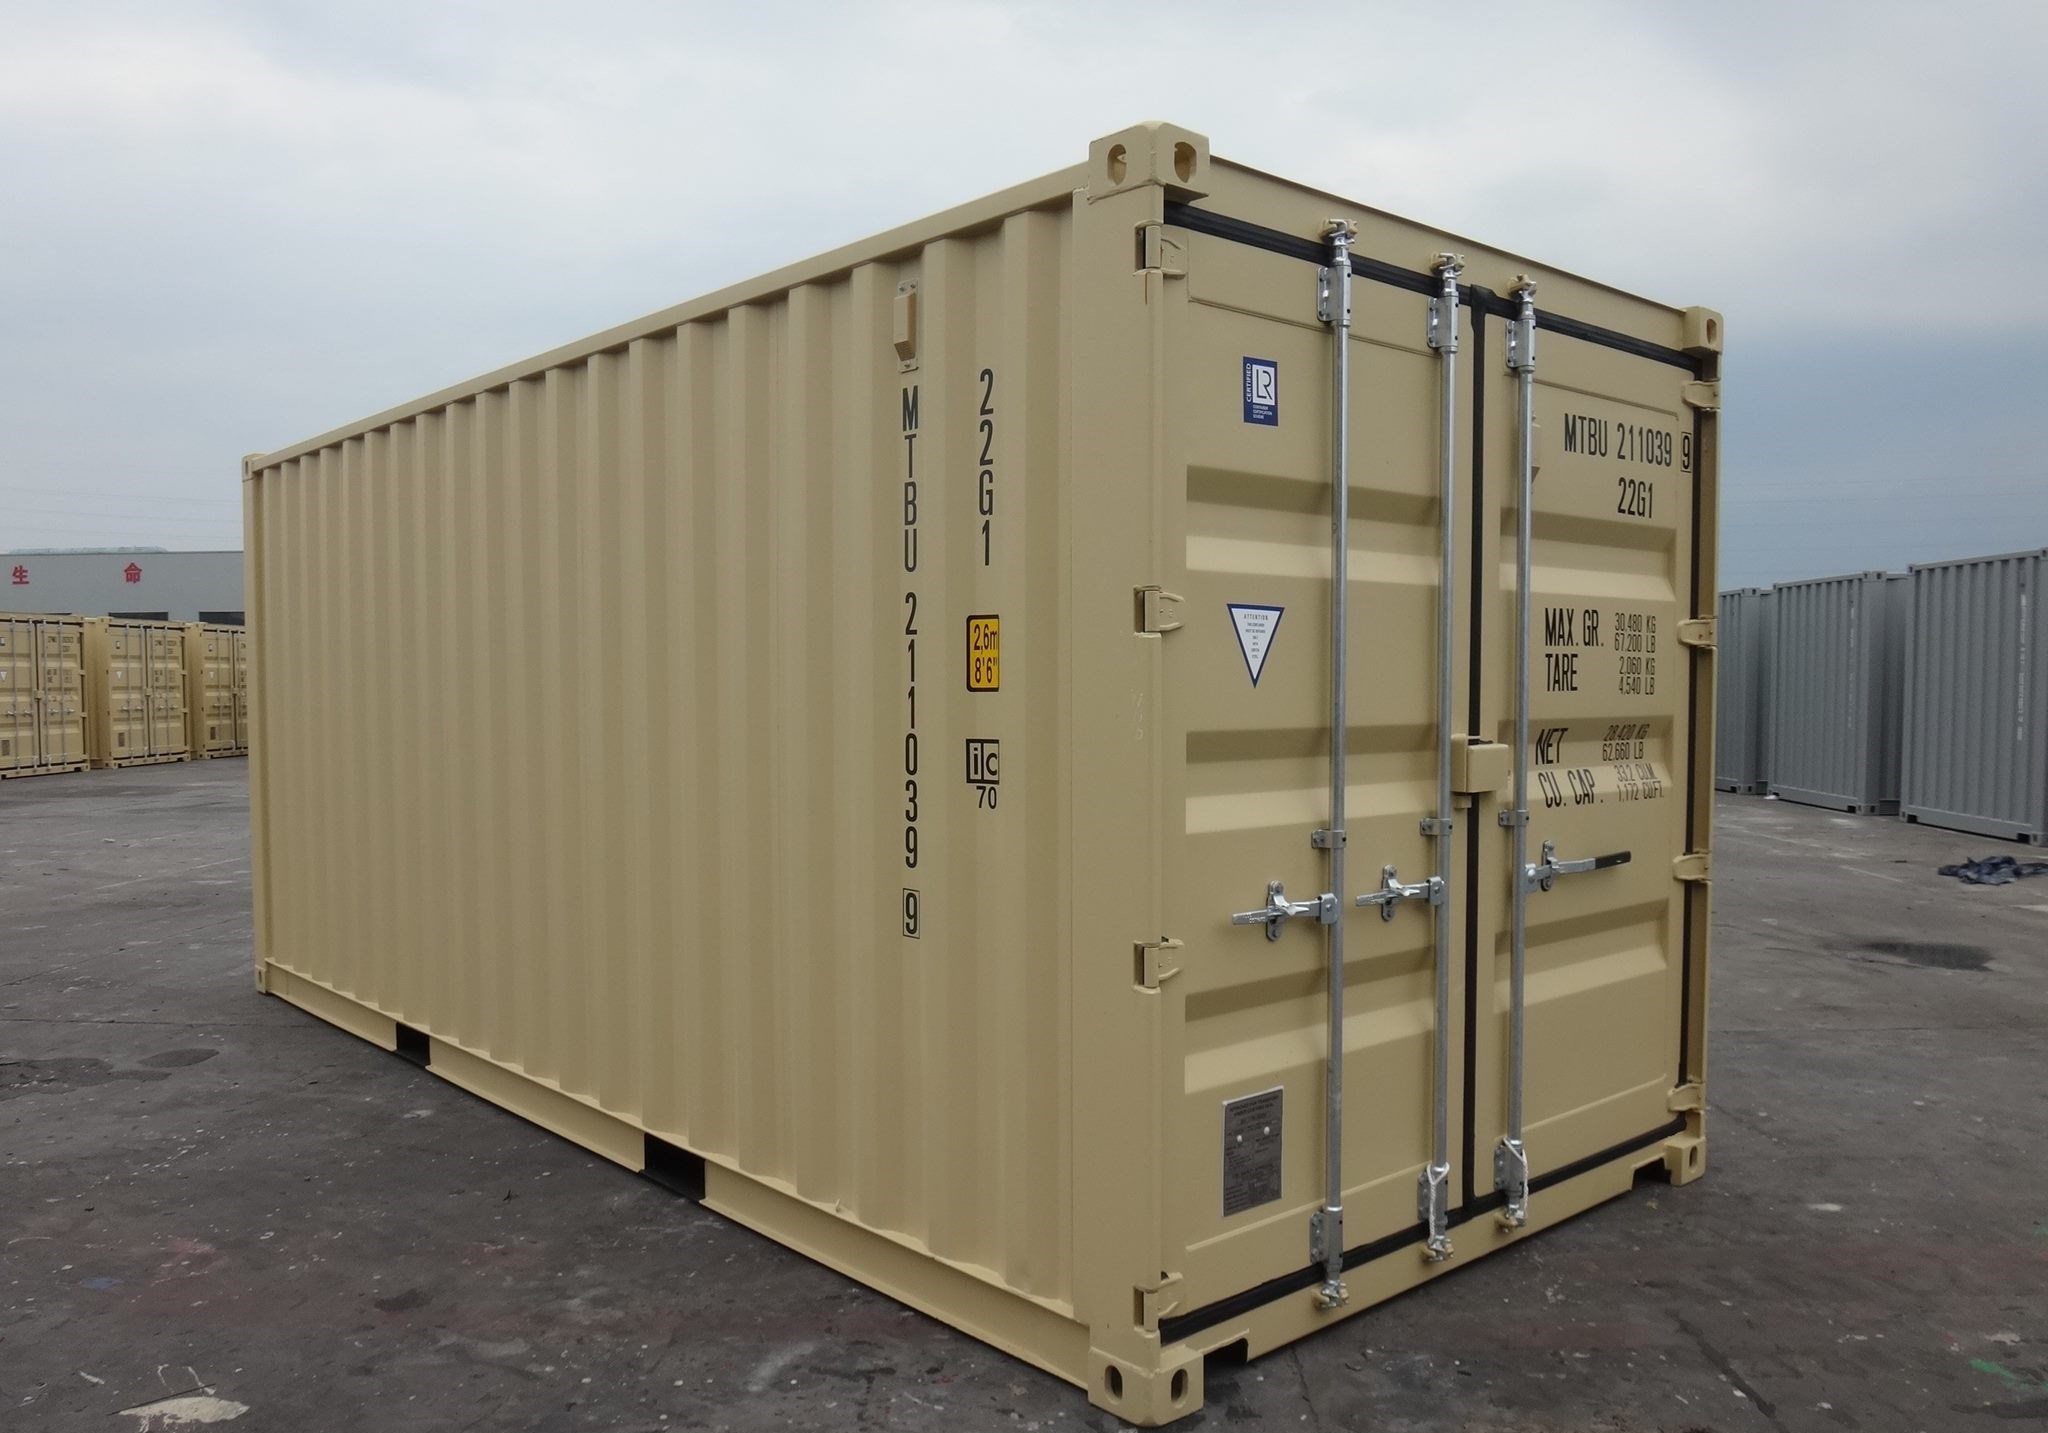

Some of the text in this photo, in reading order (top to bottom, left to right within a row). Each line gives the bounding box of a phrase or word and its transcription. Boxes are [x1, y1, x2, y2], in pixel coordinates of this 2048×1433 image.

[1256, 368, 1273, 401] LR
[1564, 413, 1690, 469] MTBU 211039 9
[979, 368, 994, 566] 22G1
[1617, 477, 1653, 519] 22G1
[12, 562, 142, 585] 生 命
[1545, 608, 1579, 646] MAX.
[1583, 609, 1604, 647] GR.
[1647, 615, 1656, 634] KG
[1646, 635, 1655, 653] LB
[902, 385, 919, 935] MTBU 211039 9
[1545, 653, 1578, 692] TARE
[1645, 657, 1655, 676] KG
[1645, 677, 1655, 695] LB
[1535, 727, 1569, 765] NET
[1634, 741, 1644, 760] LB
[976, 785, 997, 810] 70
[1538, 771, 1567, 808] CU.
[1567, 769, 1603, 806] CAP.
